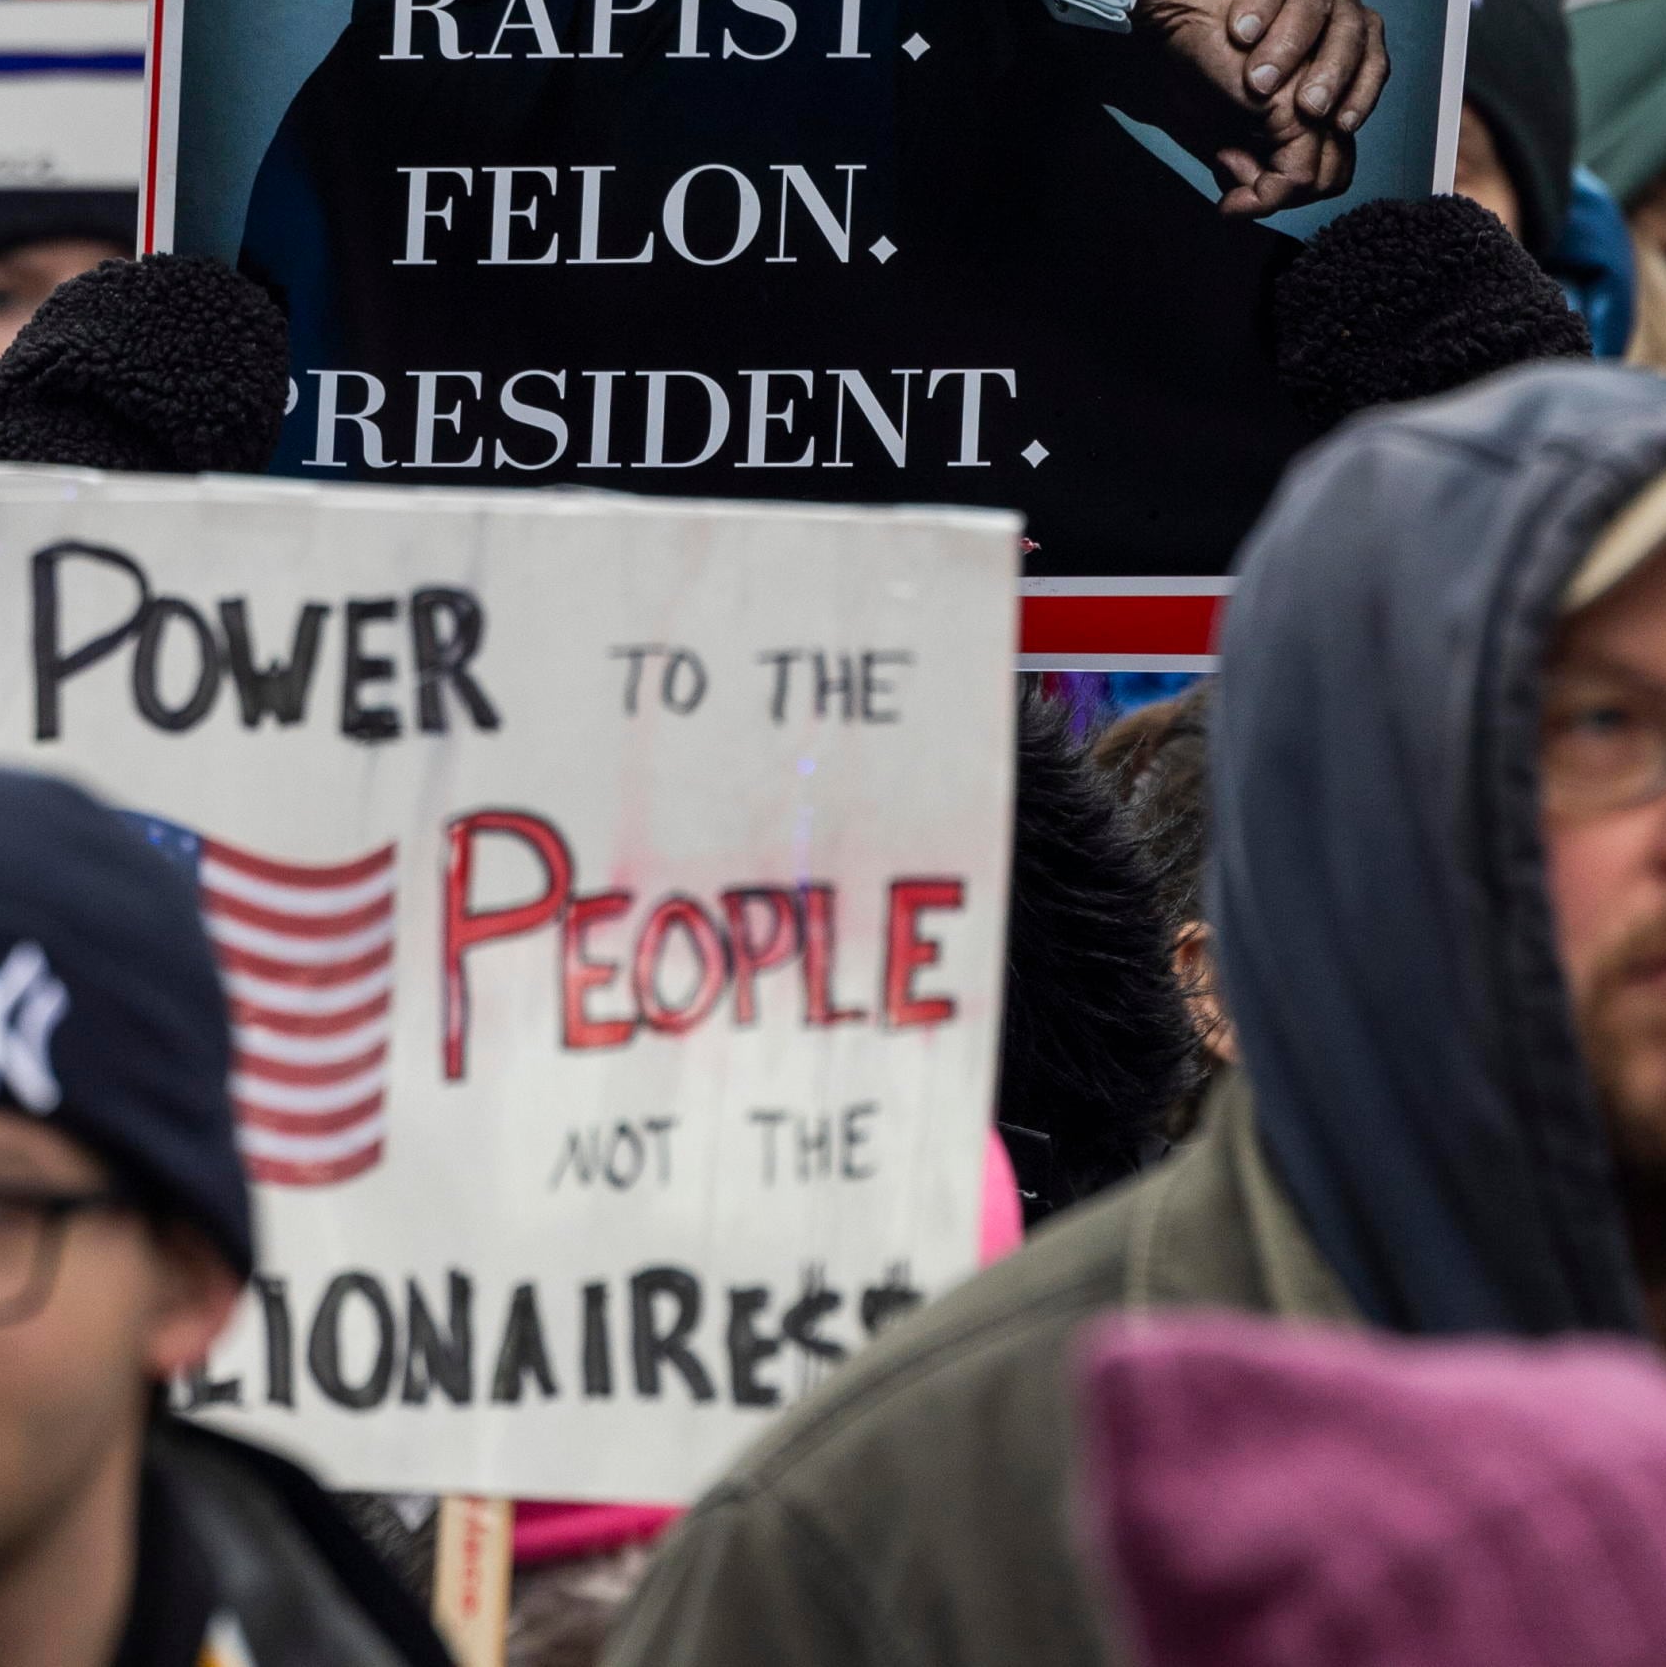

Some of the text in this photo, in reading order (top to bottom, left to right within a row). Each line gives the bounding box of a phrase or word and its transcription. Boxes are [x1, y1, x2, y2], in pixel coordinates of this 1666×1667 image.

[392, 164, 900, 266] FELON.
[284, 367, 1051, 471] RESIDENT.
[30, 539, 916, 741] POWER TO THE
[441, 808, 967, 1085] PEOPLE
[546, 1101, 884, 1195] NOT THE
